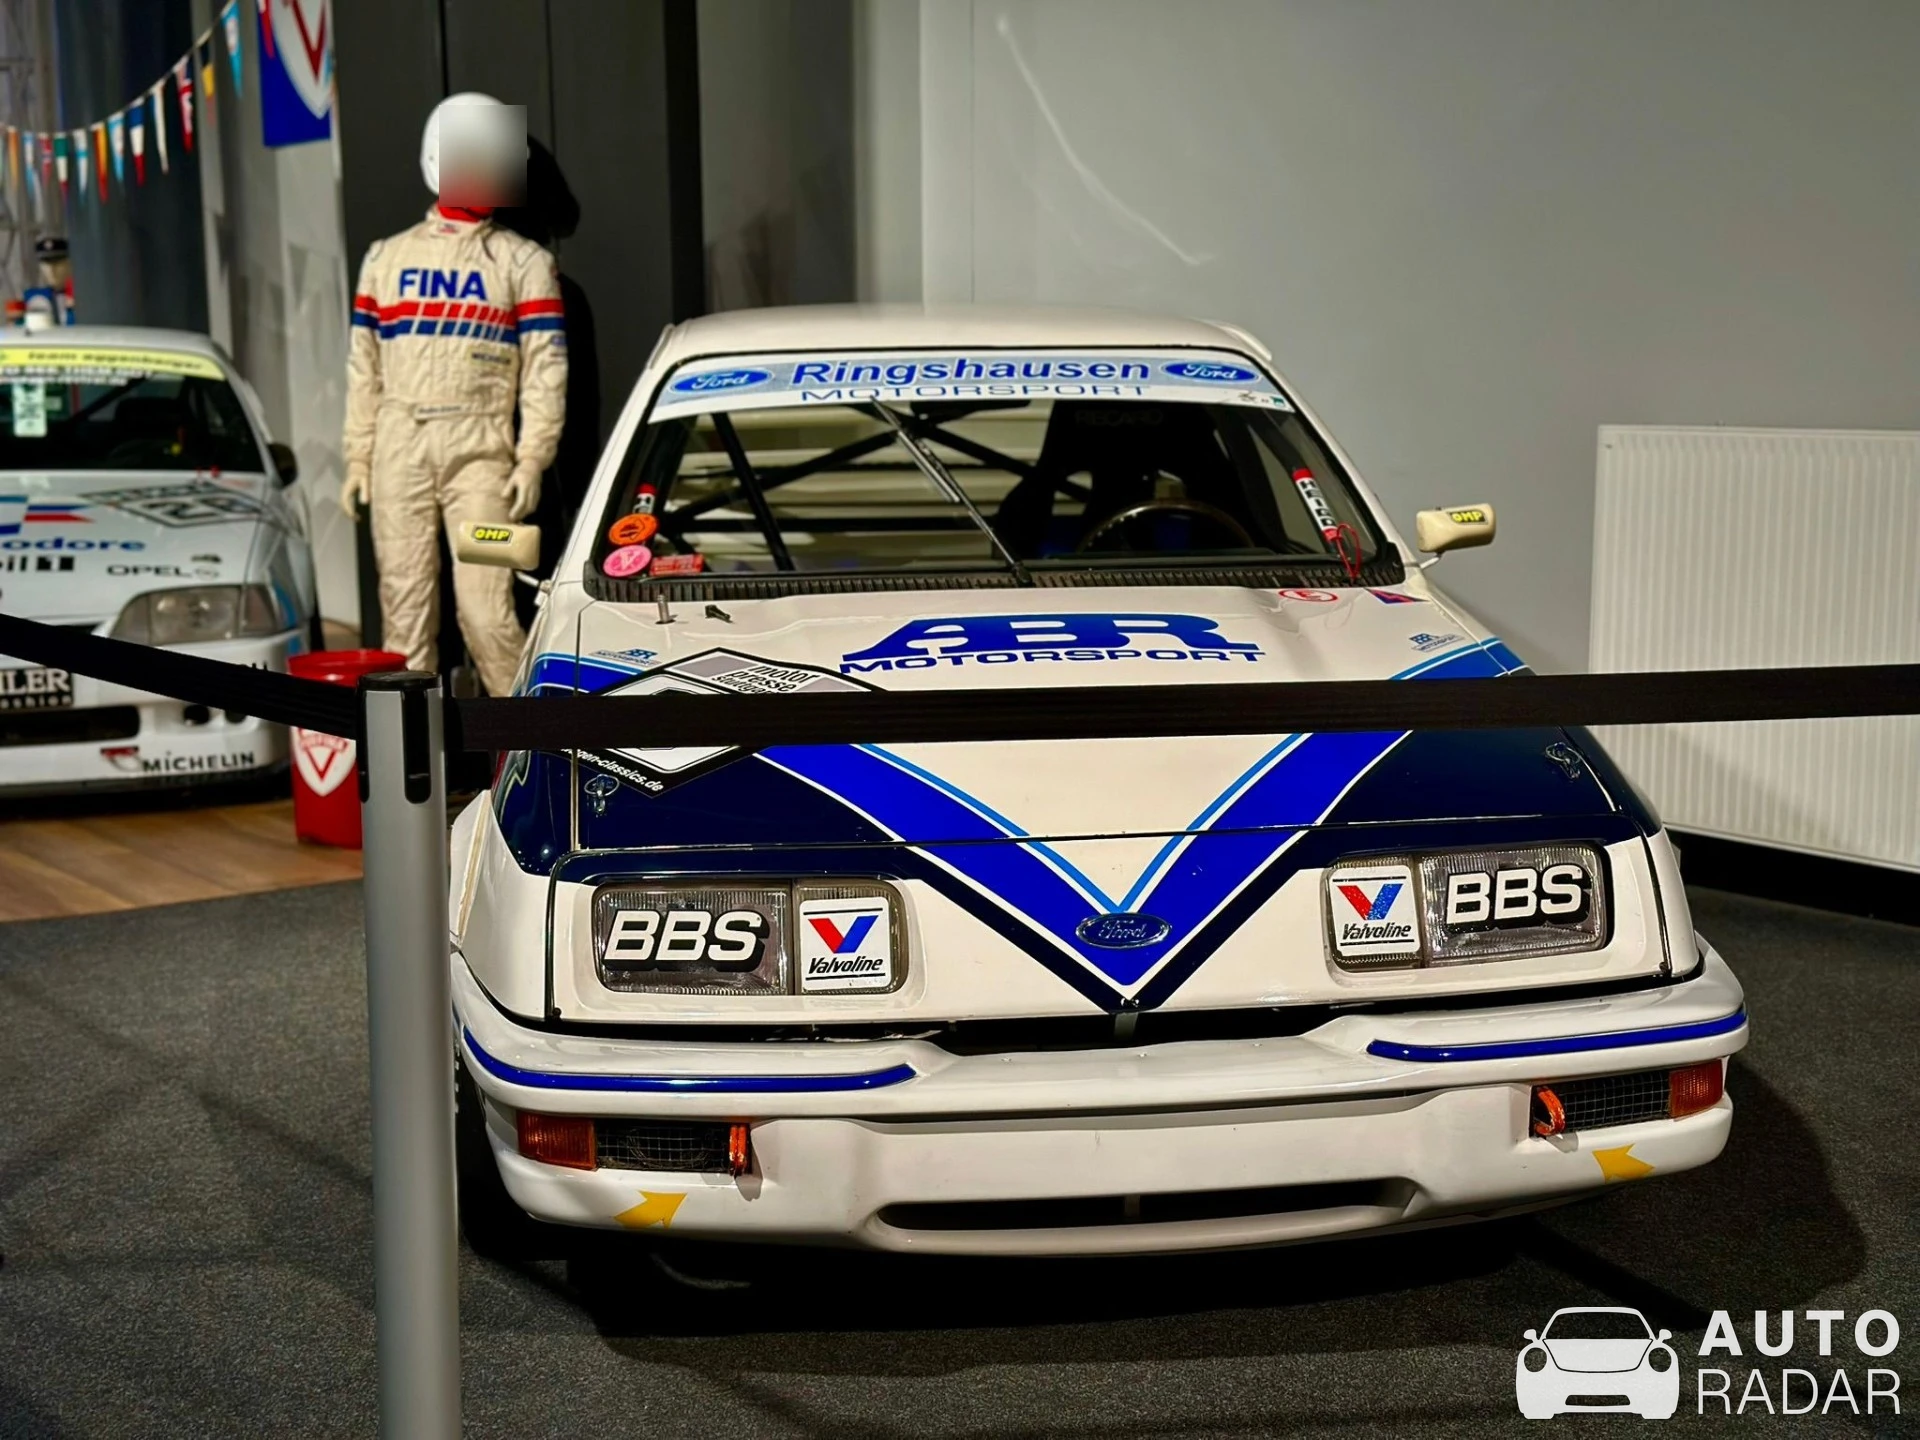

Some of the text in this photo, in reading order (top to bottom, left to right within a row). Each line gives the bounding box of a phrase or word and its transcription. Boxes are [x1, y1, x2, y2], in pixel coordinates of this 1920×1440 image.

[399, 268, 488, 301] FINA
[792, 358, 1150, 387] Ringshausen
[801, 384, 1151, 402] MOTORSPORT
[1451, 509, 1484, 523] OMP
[474, 527, 511, 542] OMP
[106, 565, 191, 577] OPEL
[840, 650, 1267, 674] MOTORSPORT
[712, 676, 776, 694] stuttga
[726, 670, 797, 692] presse
[748, 665, 821, 684] motor
[142, 751, 255, 773] MICHELIN
[1445, 864, 1584, 926] BBS
[604, 909, 764, 962] BBS
[1097, 919, 1147, 940] Ford
[1341, 920, 1412, 941] Valvoline
[808, 954, 884, 976] Valvoline
